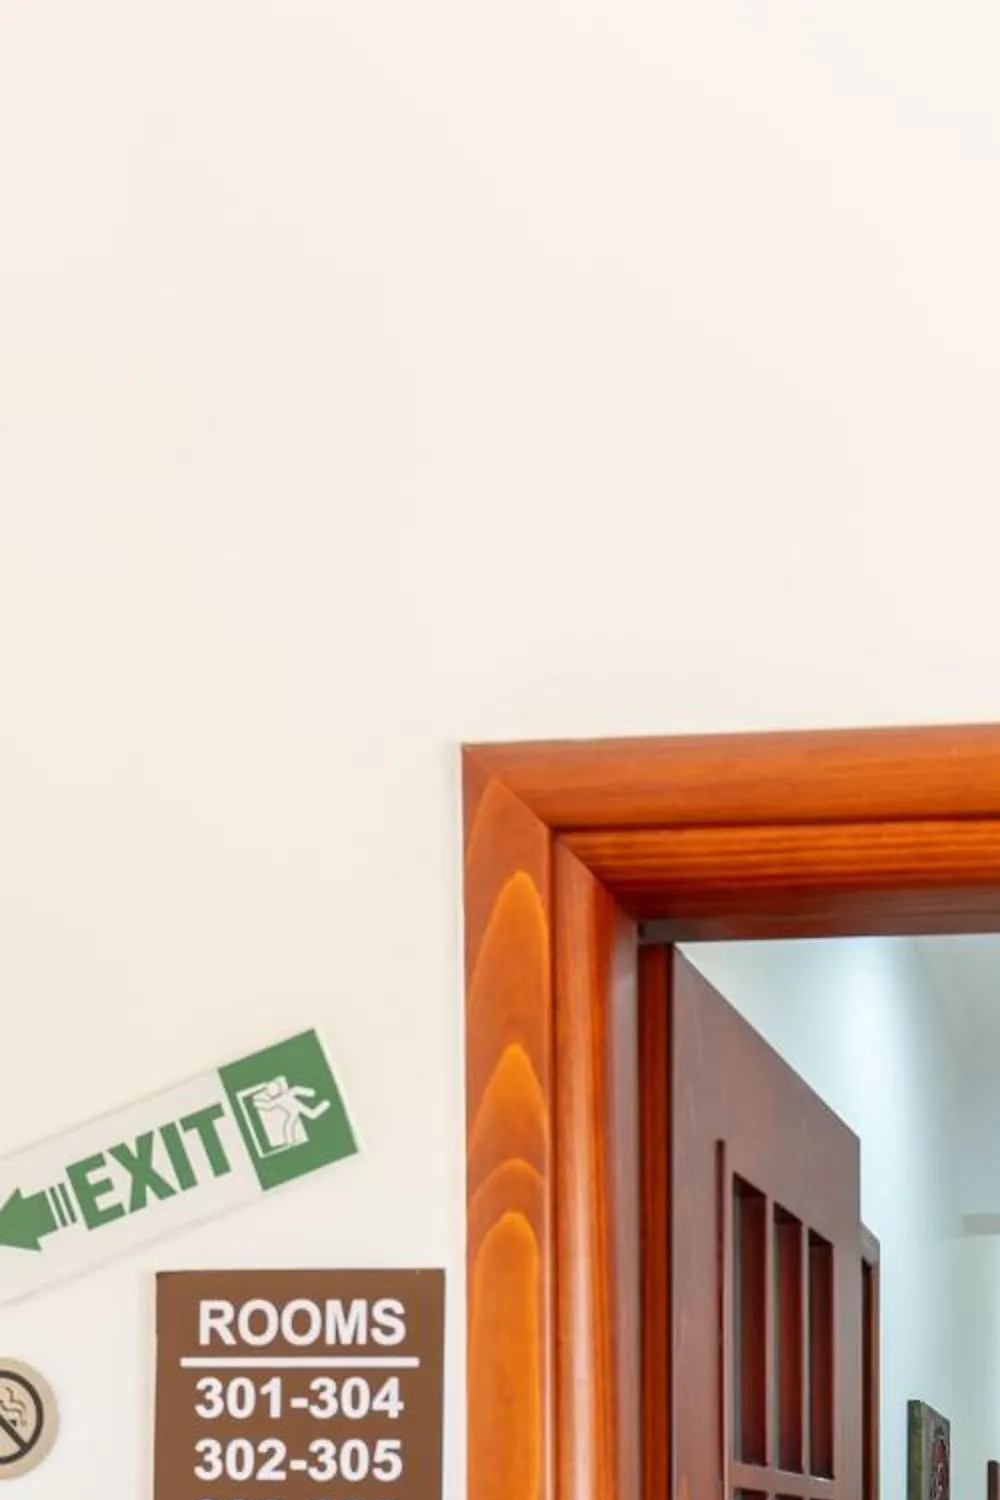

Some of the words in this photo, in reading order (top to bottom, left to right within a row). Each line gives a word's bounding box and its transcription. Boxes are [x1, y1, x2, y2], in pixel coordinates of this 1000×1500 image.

[66, 1104, 231, 1230] EXIT
[199, 1299, 406, 1346] ROOMS
[195, 1376, 404, 1420] 301-304
[194, 1438, 403, 1481] 302-305
